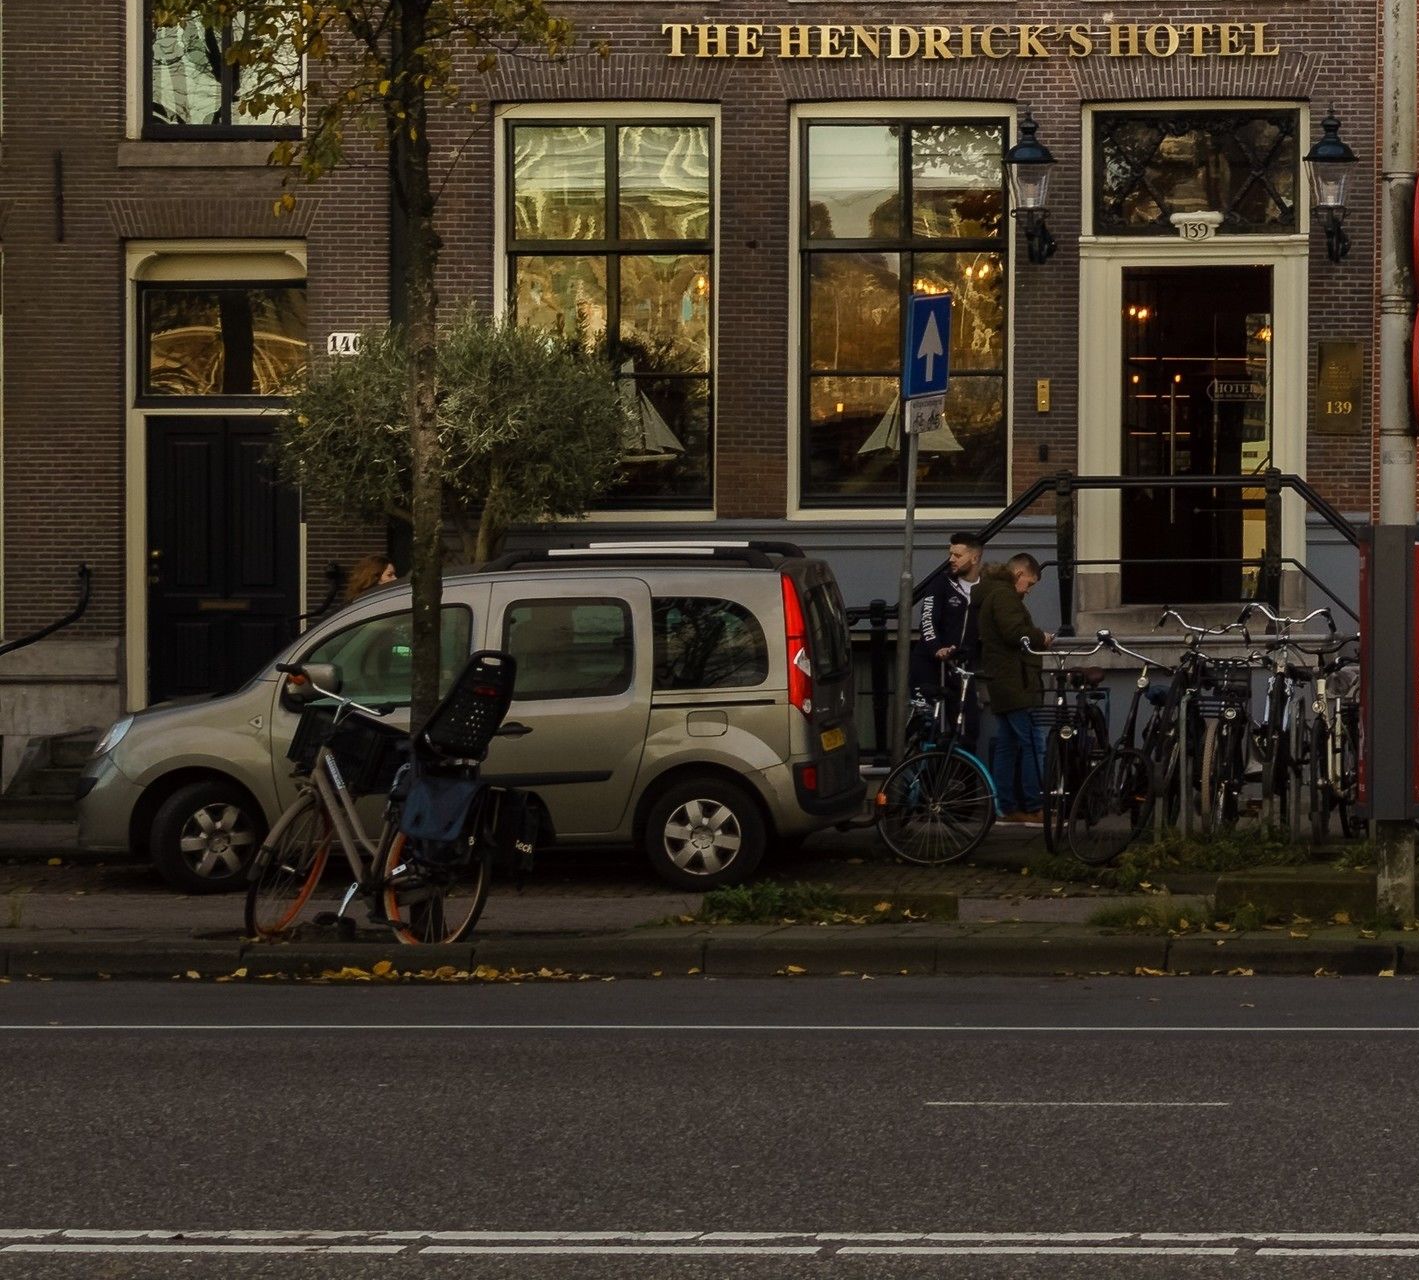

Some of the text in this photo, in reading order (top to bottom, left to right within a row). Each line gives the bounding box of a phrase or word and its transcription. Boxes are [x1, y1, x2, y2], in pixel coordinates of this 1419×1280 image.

[661, 21, 1280, 59] THE HENDRICK'S HOTEL
[1183, 222, 1209, 239] 139
[1326, 400, 1353, 414] 139
